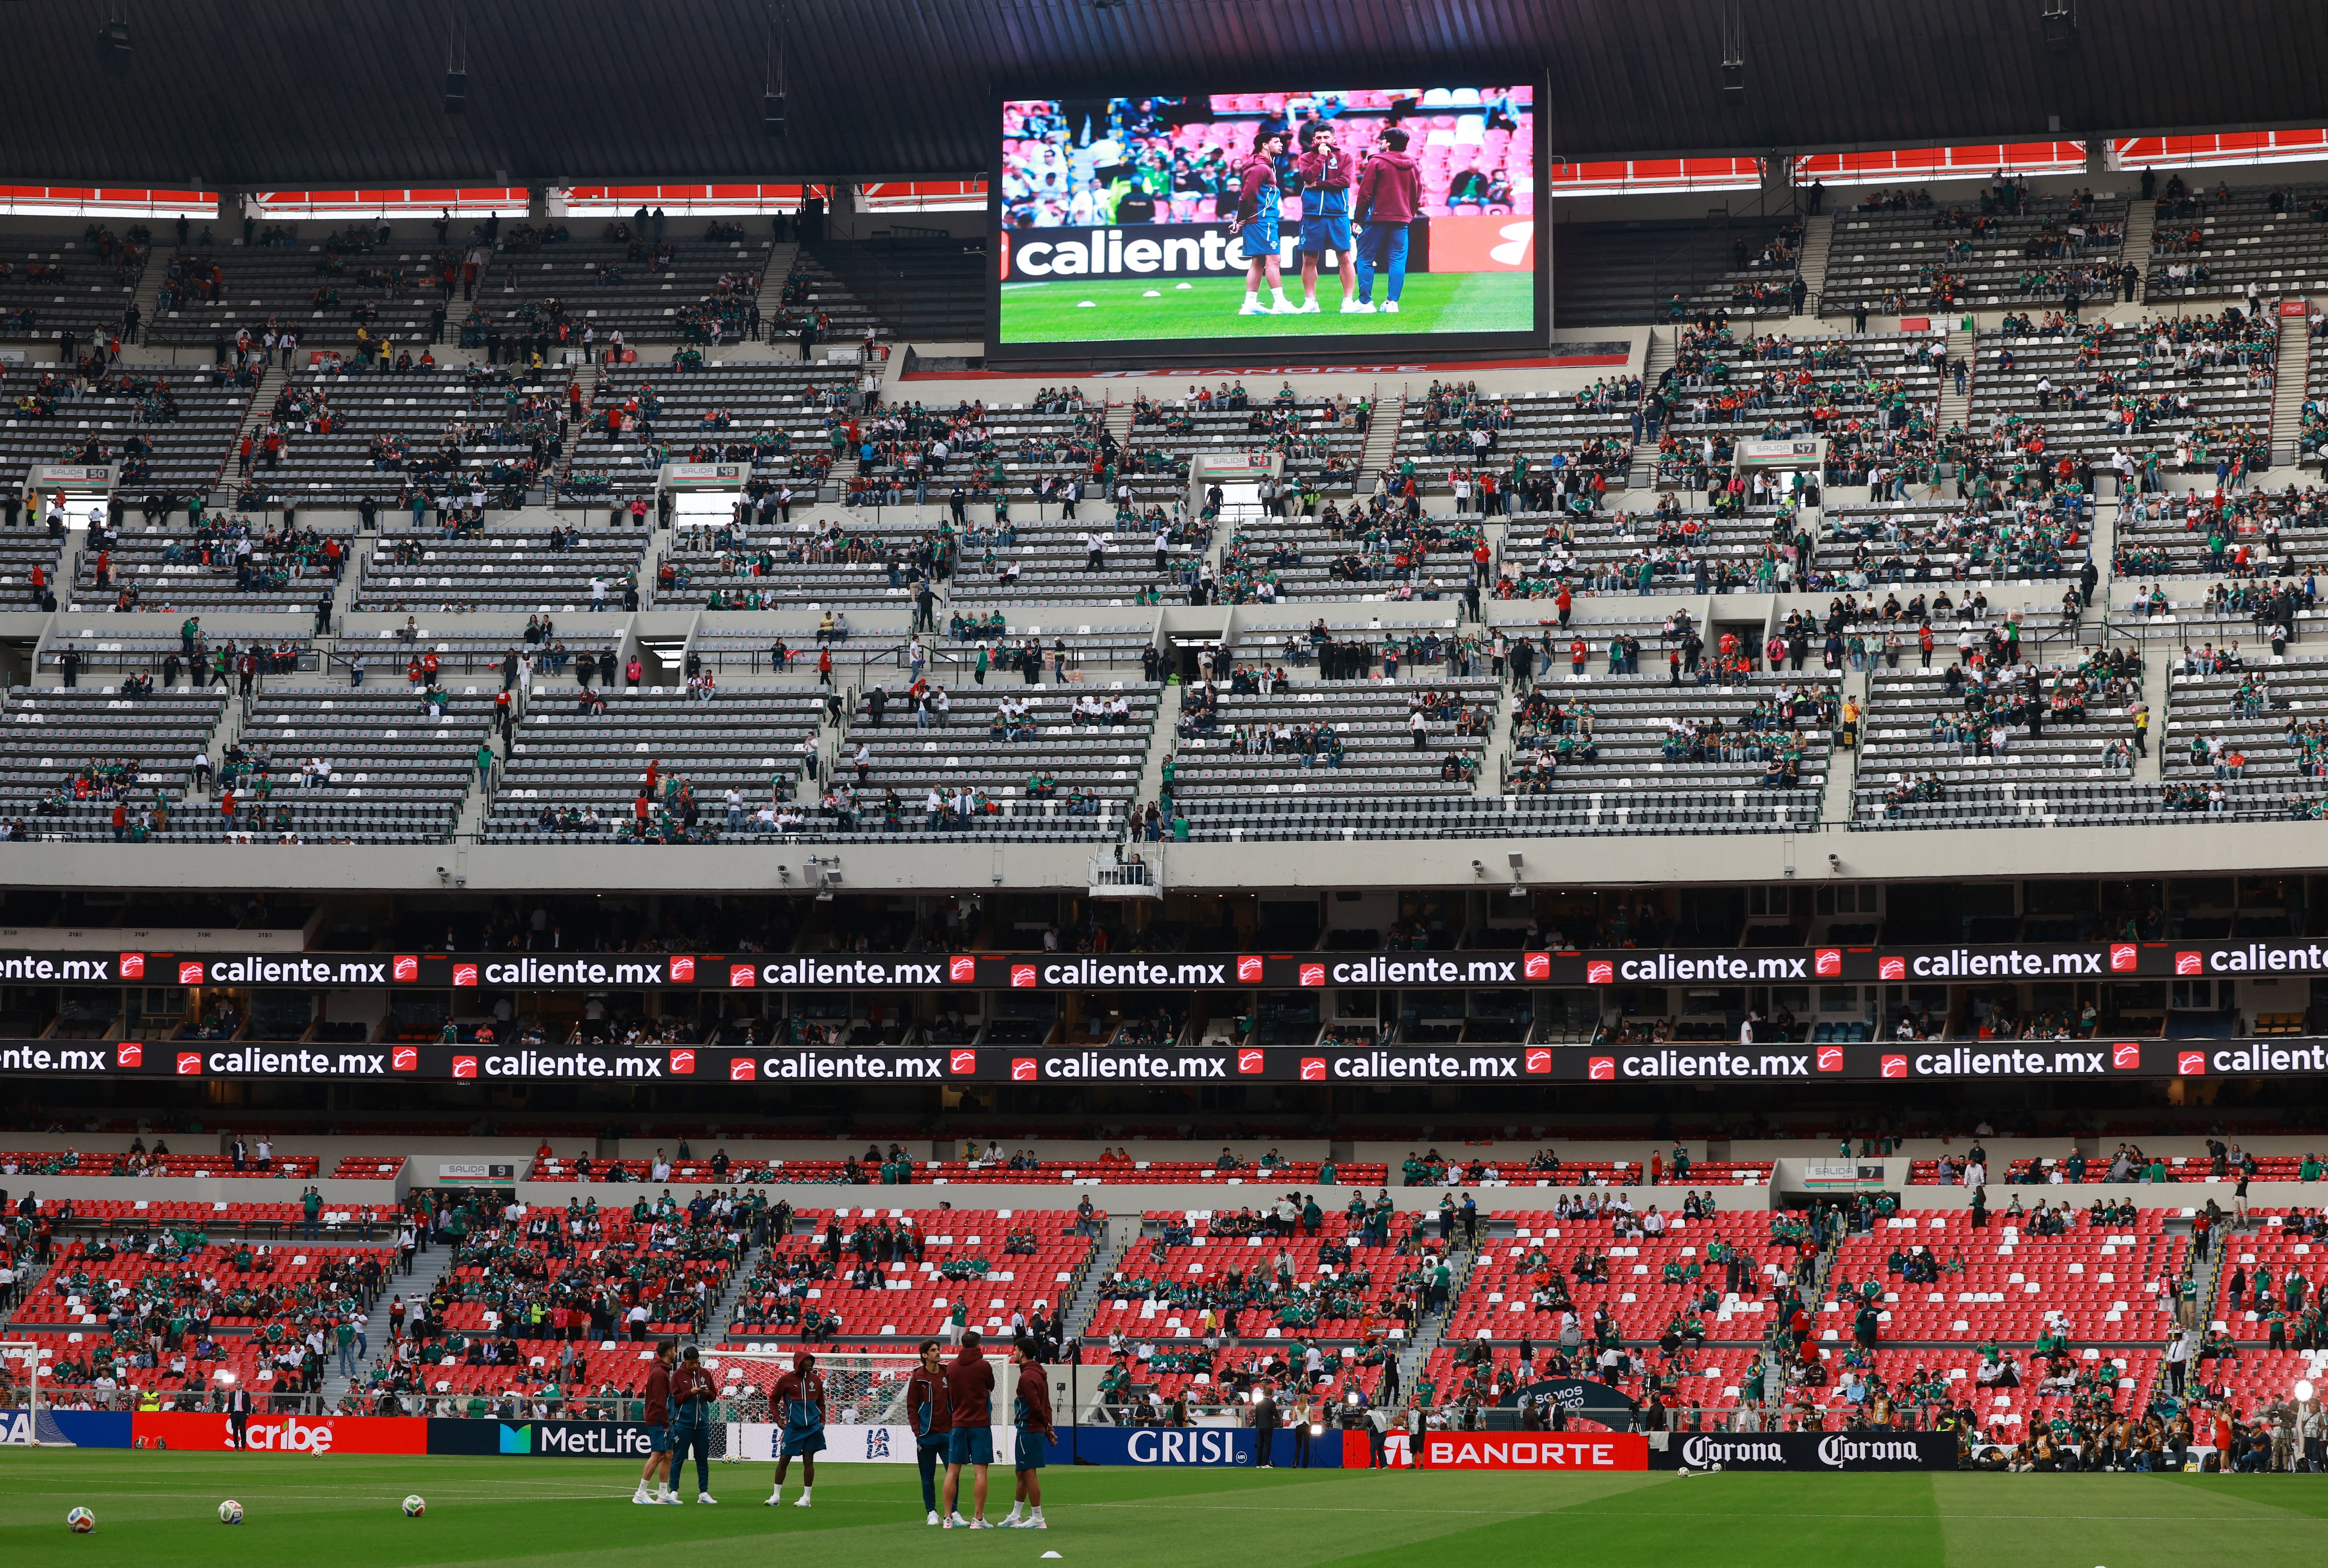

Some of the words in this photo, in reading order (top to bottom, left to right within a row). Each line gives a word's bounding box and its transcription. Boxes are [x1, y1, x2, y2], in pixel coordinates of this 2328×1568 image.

[1169, 365, 1428, 376] BANORTE
[1797, 444, 1813, 453] 47
[90, 469, 105, 478] 50
[720, 467, 735, 476] 49
[749, 597, 754, 606] 9
[211, 957, 385, 982] caliente.mx
[486, 959, 662, 983] caliente.mx
[764, 959, 941, 983] caliente.mx
[1045, 960, 1225, 984] caliente.mx
[1333, 957, 1516, 982] caliente.mx
[1621, 954, 1807, 980] caliente.mx
[1913, 950, 2102, 976] caliente.mx
[210, 1048, 384, 1073] caliente.mx
[485, 1051, 661, 1076] caliente.mx
[764, 1053, 941, 1077] caliente.mx
[1045, 1053, 1225, 1077] caliente.mx
[1334, 1052, 1517, 1077] caliente.mx
[1623, 1051, 1808, 1076] caliente.mx
[1916, 1048, 2104, 1074] caliente.mx
[497, 1166, 506, 1176] 9
[1867, 1167, 1875, 1177] 7
[1535, 1386, 1583, 1404] SOMOS
[224, 1418, 332, 1450] Scribe
[541, 1426, 651, 1453] MetLife
[1128, 1431, 1233, 1463] GRISI
[1432, 1443, 1613, 1464] BANORTE
[1683, 1436, 1783, 1471] Corona
[1818, 1435, 1919, 1468] Corona
